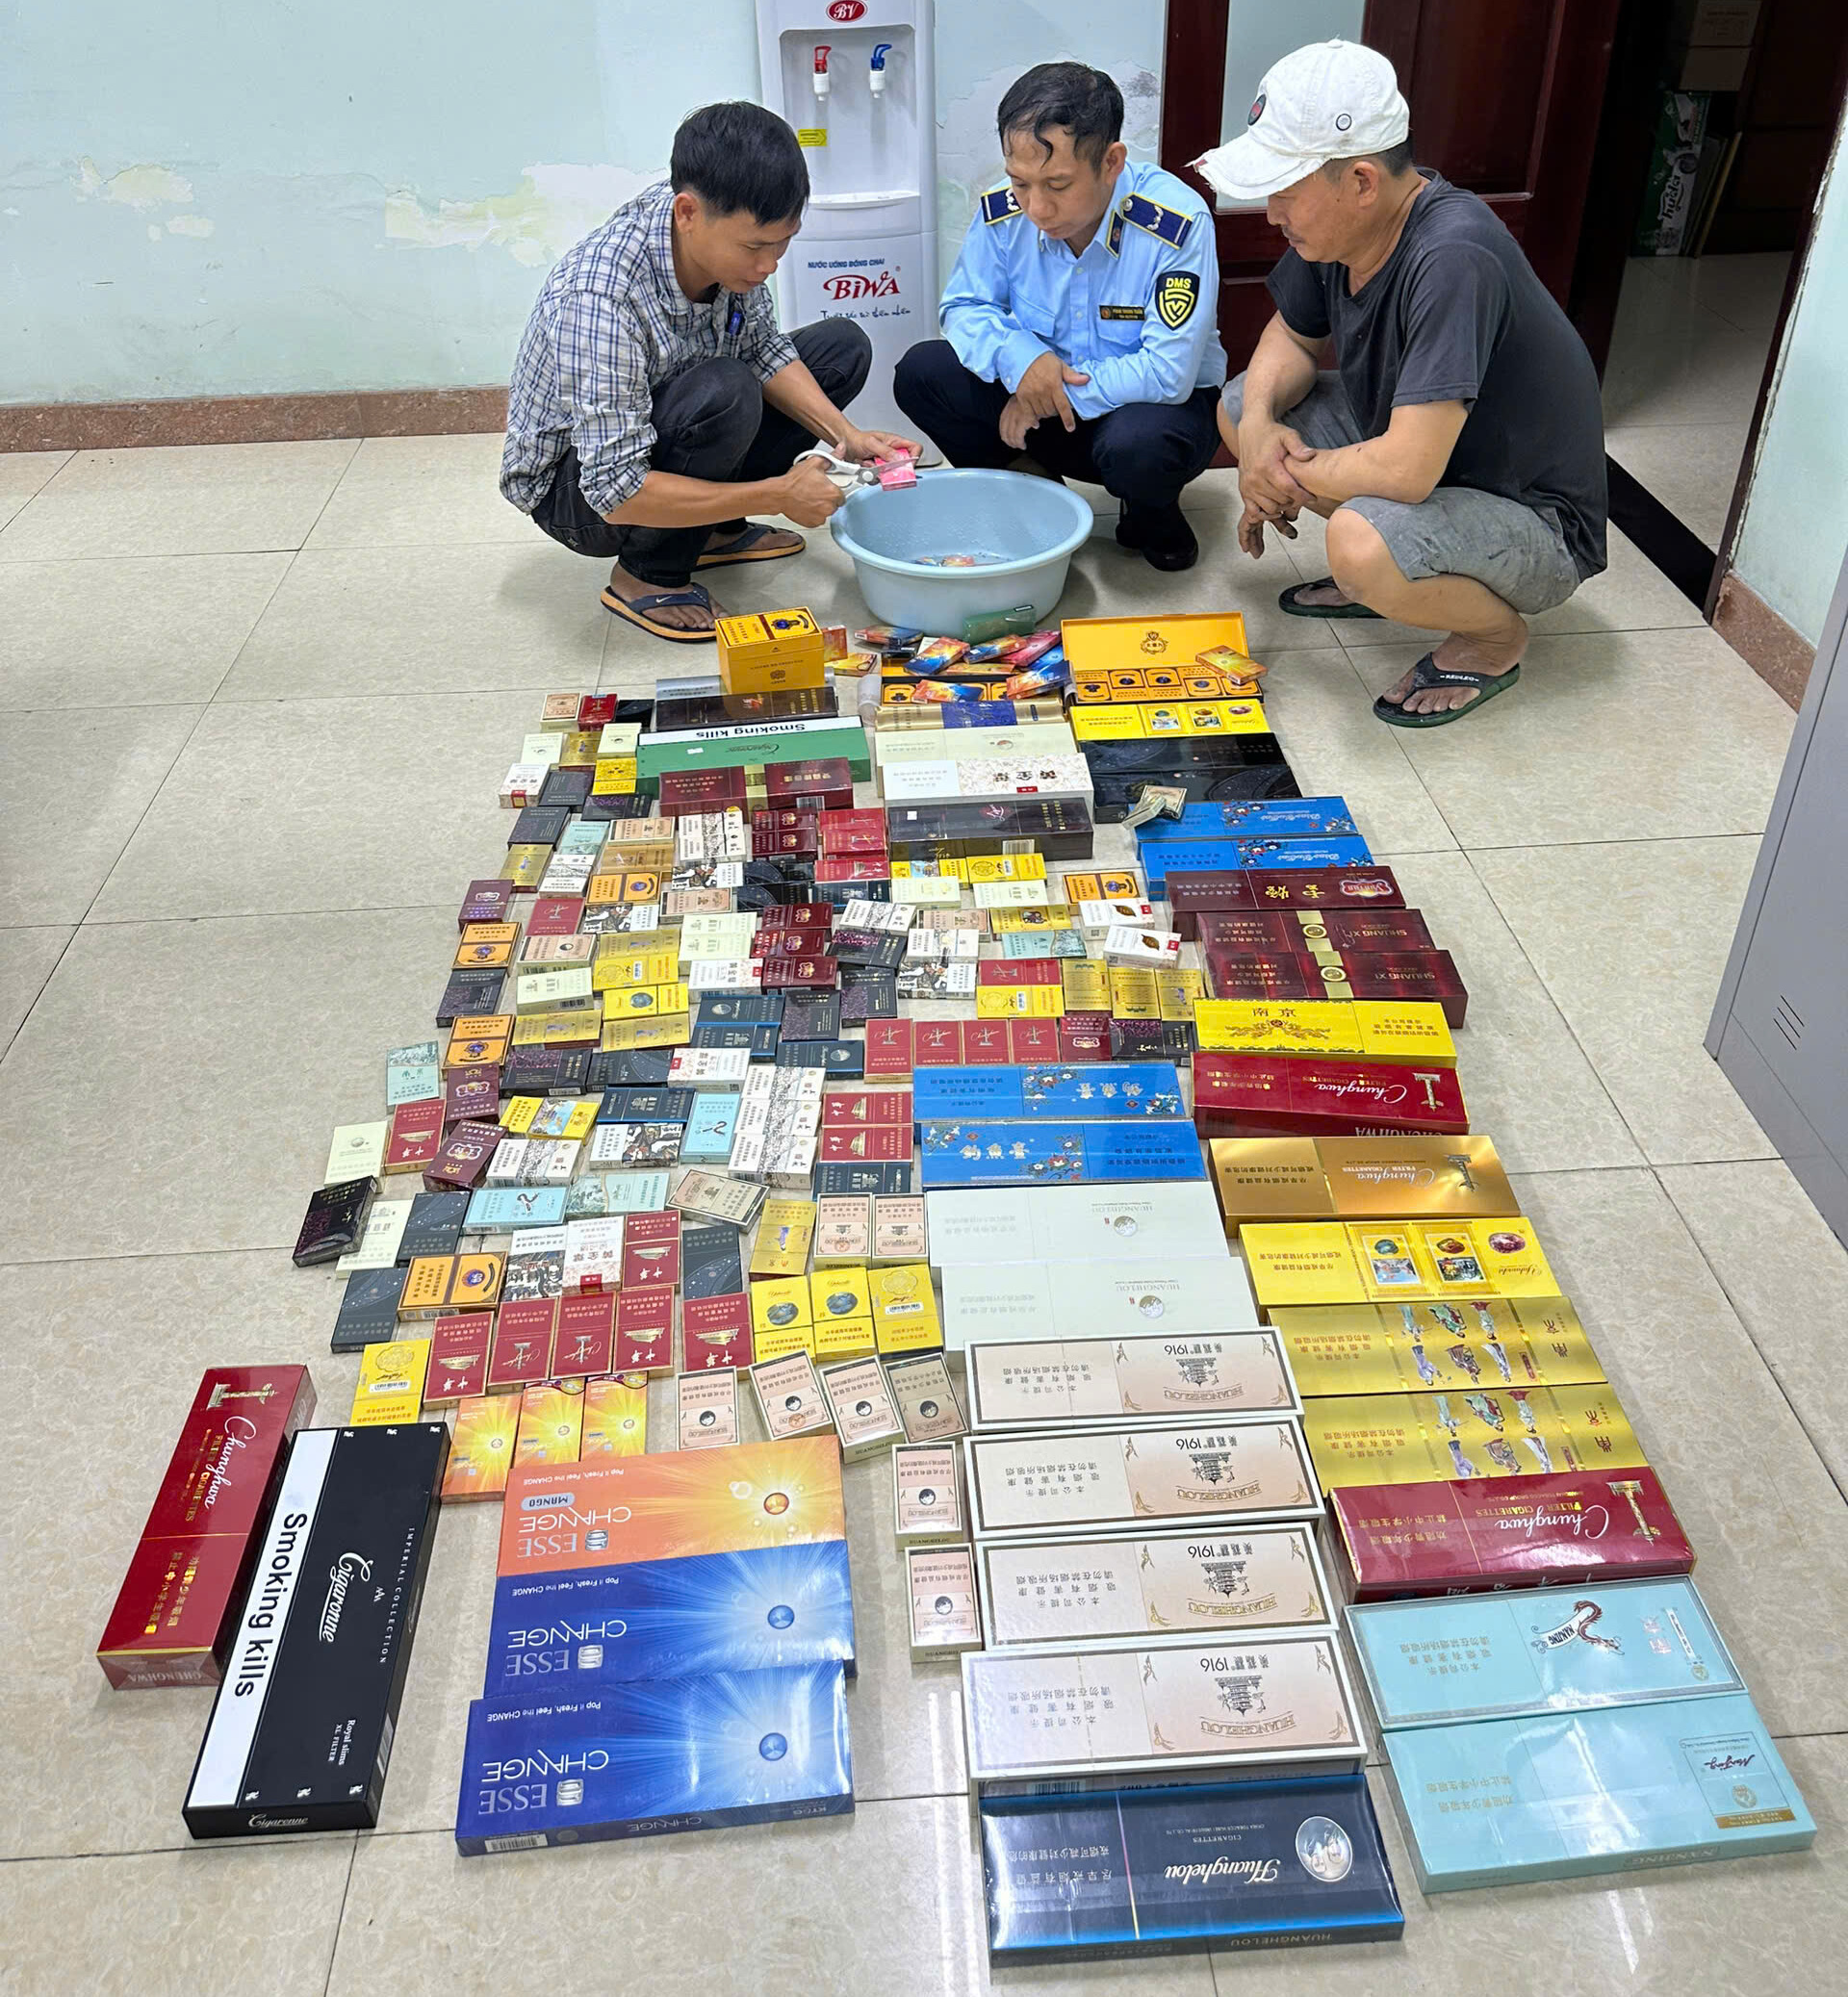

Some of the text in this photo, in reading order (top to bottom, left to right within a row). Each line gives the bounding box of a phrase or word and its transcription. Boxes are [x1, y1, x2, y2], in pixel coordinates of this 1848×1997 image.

[833, 2, 860, 19] BV
[1166, 277, 1193, 289] DMS
[695, 723, 807, 739] Smoking kills
[1389, 971, 1436, 980] SHUANG
[1312, 1080, 1408, 1104] Chunghwa
[1356, 1167, 1435, 1188] Chunghwa
[1164, 1344, 1189, 1356] 1916
[1163, 1386, 1244, 1402] HUANGHELOU
[1175, 1438, 1202, 1450] 1916
[204, 1415, 257, 1510] Chunghwa
[523, 1476, 553, 1486] CHANGE
[1176, 1483, 1261, 1501] HUANGHELOU
[528, 1496, 569, 1507] MANGO
[1476, 1501, 1582, 1517] FILTER CIGARETTES
[518, 1506, 632, 1533] CHANGE
[1494, 1504, 1609, 1540] Chunghwa
[516, 1533, 578, 1558] ESSE
[1187, 1544, 1216, 1558] 1916
[558, 1581, 575, 1590] Feel
[576, 1579, 598, 1589] Fresh,
[604, 1576, 620, 1586] Pop
[1015, 1570, 1114, 1585] 请勿在禁烟场所吸烟
[378, 1526, 417, 1665] IMPERIAL COLLECTION
[512, 1585, 545, 1598] CHANGE
[545, 1583, 557, 1592] the
[1017, 1581, 1116, 1598] 吸烟有害健康
[234, 1512, 308, 1698] Smoking kills
[319, 1550, 374, 1644] Cigaronne
[1037, 1596, 1100, 1609] 本公司提示
[1187, 1596, 1276, 1615] HUANGHELOU
[506, 1619, 628, 1649] CHANGE
[505, 1649, 570, 1677] ESSE
[1199, 1656, 1229, 1672] 1916
[1006, 1685, 1112, 1702] 请勿在禁烟场所吸烟
[522, 1709, 535, 1718] the
[536, 1707, 552, 1716] Feel
[553, 1703, 578, 1715] Fresh,
[585, 1702, 602, 1710] Pop
[1008, 1699, 1114, 1714] 吸烟有害健康
[486, 1709, 521, 1723] CHANGE
[1029, 1716, 1096, 1729] 本公司提示
[1199, 1713, 1295, 1735] HUANGHELOU
[327, 1723, 344, 1762] XL FILTER
[338, 1719, 357, 1766] Royal slims
[481, 1749, 609, 1781] CHANGE
[477, 1782, 548, 1814] ESSE
[627, 1815, 703, 1832] CHANGE
[1192, 1833, 1242, 1843] CIGARETTES
[1007, 1845, 1110, 1862] 戒烟可减少对健康的危
[1164, 1856, 1281, 1885] Huanghelou
